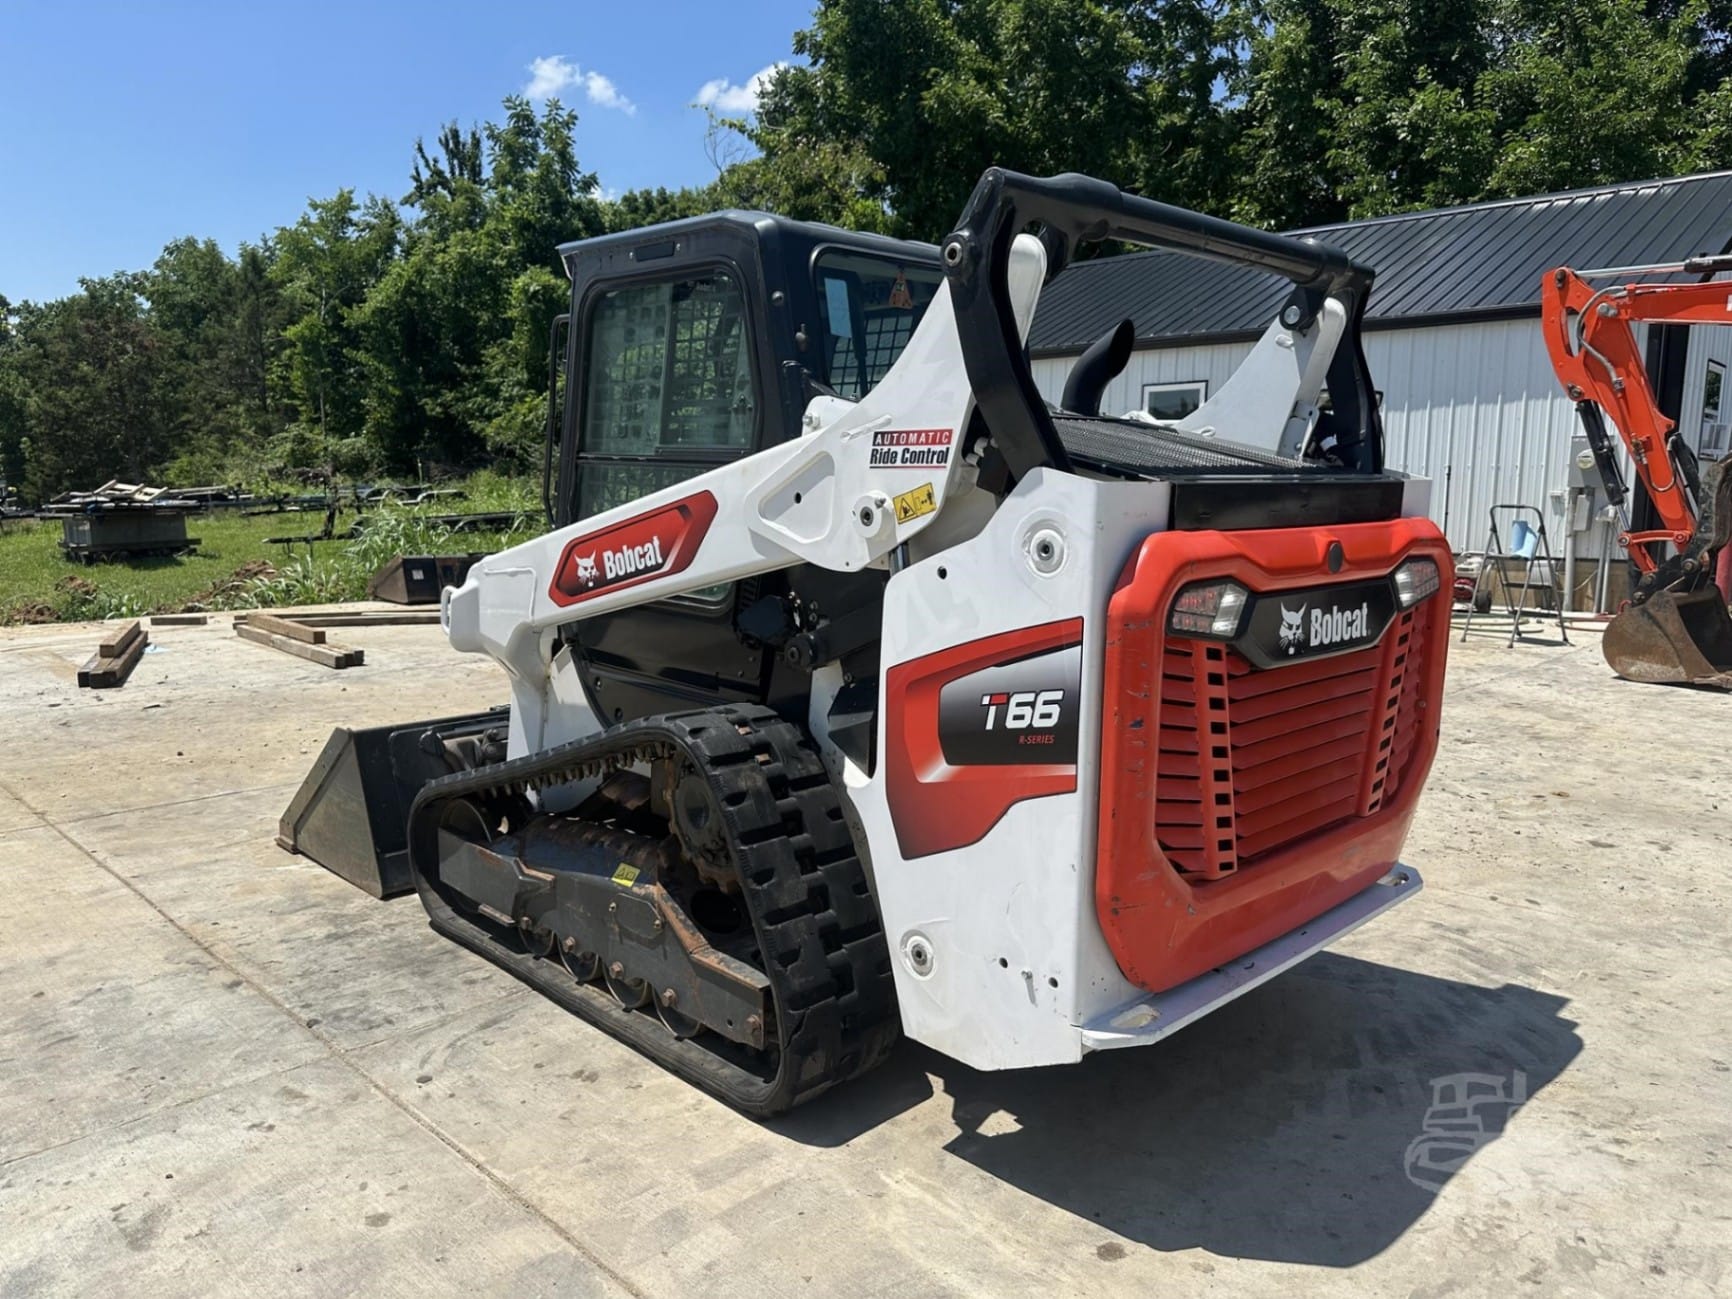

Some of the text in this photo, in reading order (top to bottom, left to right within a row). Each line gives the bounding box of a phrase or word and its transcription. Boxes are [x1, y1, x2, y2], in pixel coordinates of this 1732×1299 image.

[875, 431, 950, 445] AUTOMATIC
[869, 447, 950, 465] Ride Control
[603, 535, 663, 580] Bobcat
[1309, 601, 1368, 647] Bobcat
[981, 690, 1065, 730] T66
[1018, 734, 1056, 745] R-SERIES
